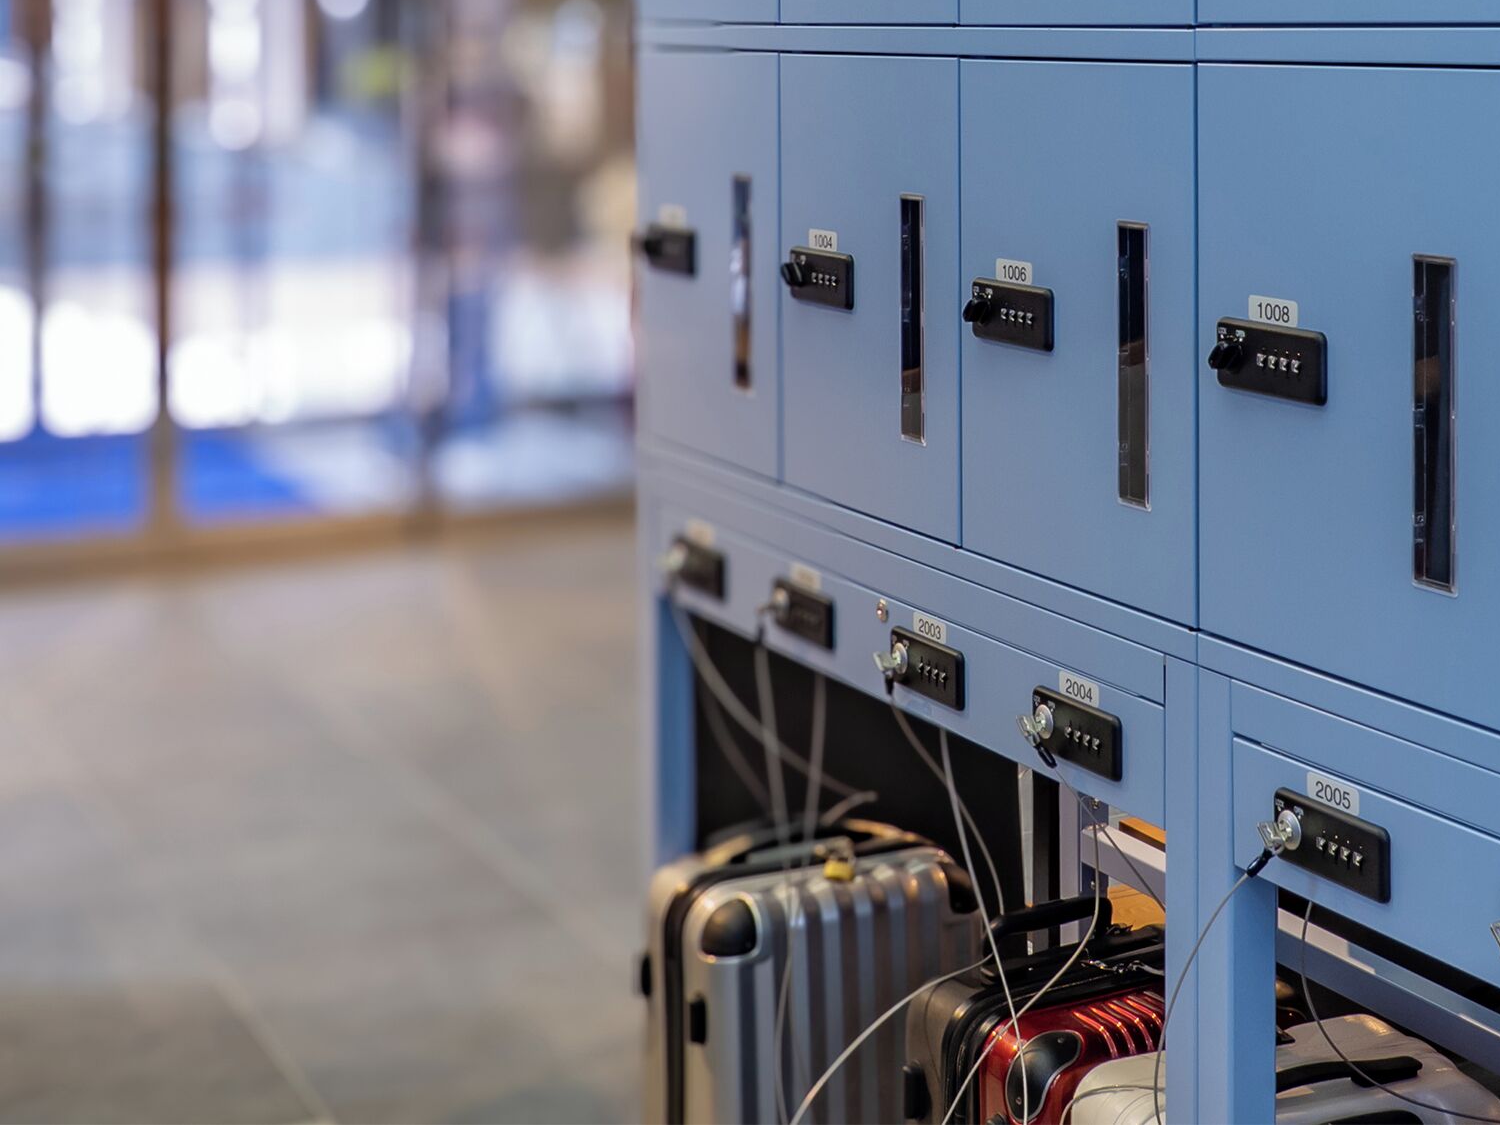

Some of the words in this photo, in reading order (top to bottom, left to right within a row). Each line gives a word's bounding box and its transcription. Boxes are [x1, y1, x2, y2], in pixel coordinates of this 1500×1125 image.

[813, 233, 833, 249] 1004
[1002, 265, 1027, 282] 1006
[1257, 302, 1290, 323] 1008
[918, 618, 942, 640] 2003
[1065, 678, 1093, 703] 2004
[1316, 780, 1351, 809] 2005
